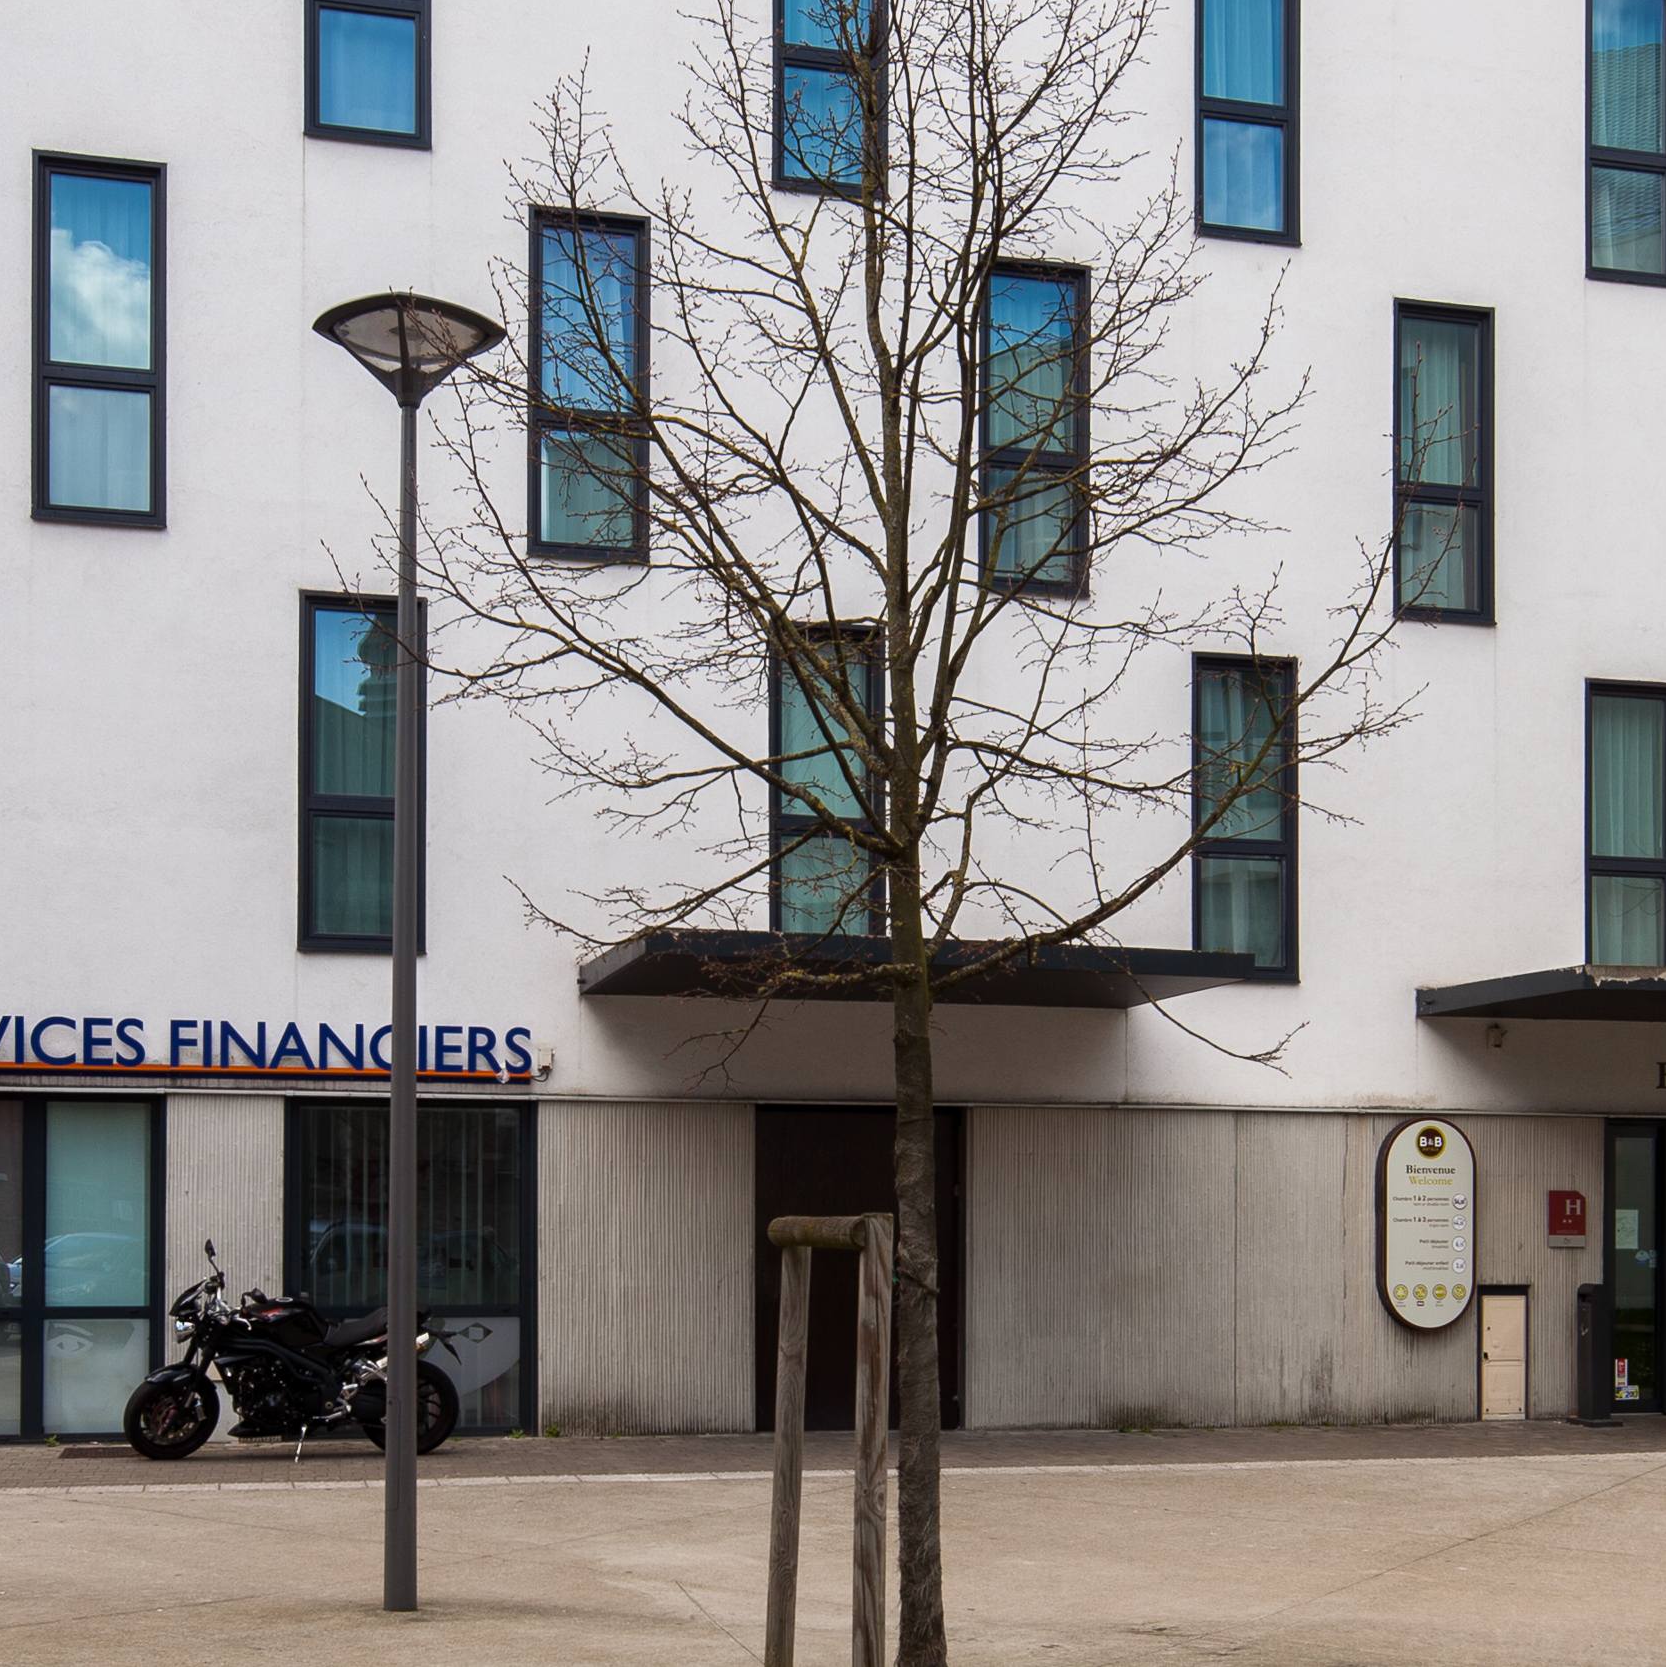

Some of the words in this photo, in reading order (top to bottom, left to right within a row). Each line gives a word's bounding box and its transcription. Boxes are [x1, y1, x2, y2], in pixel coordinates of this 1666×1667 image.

[1419, 1136, 1443, 1147] B&B
[1405, 1164, 1456, 1175] Bienvenue
[1408, 1175, 1453, 1186] Welcome
[1565, 1199, 1582, 1215] H
